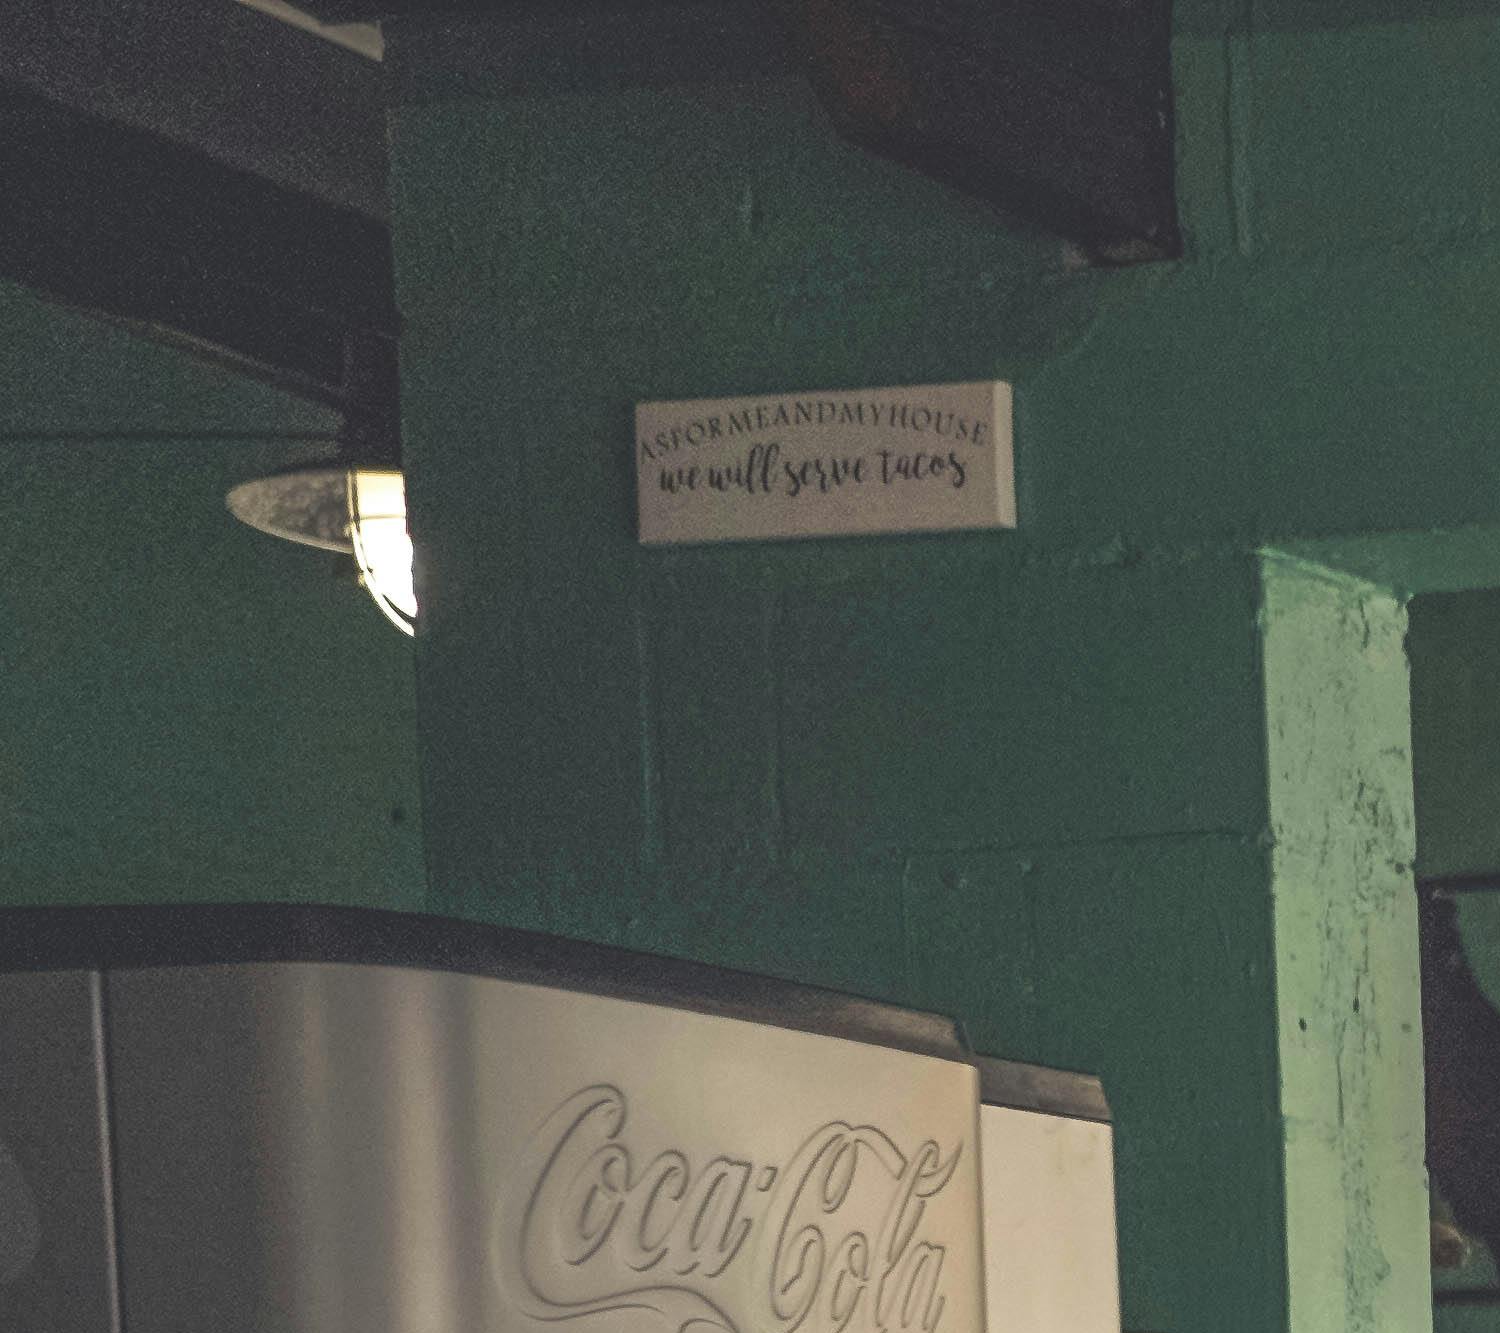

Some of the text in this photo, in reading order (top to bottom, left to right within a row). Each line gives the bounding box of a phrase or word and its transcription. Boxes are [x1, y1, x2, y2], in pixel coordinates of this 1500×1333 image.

[660, 443, 967, 497] we will serve tacos
